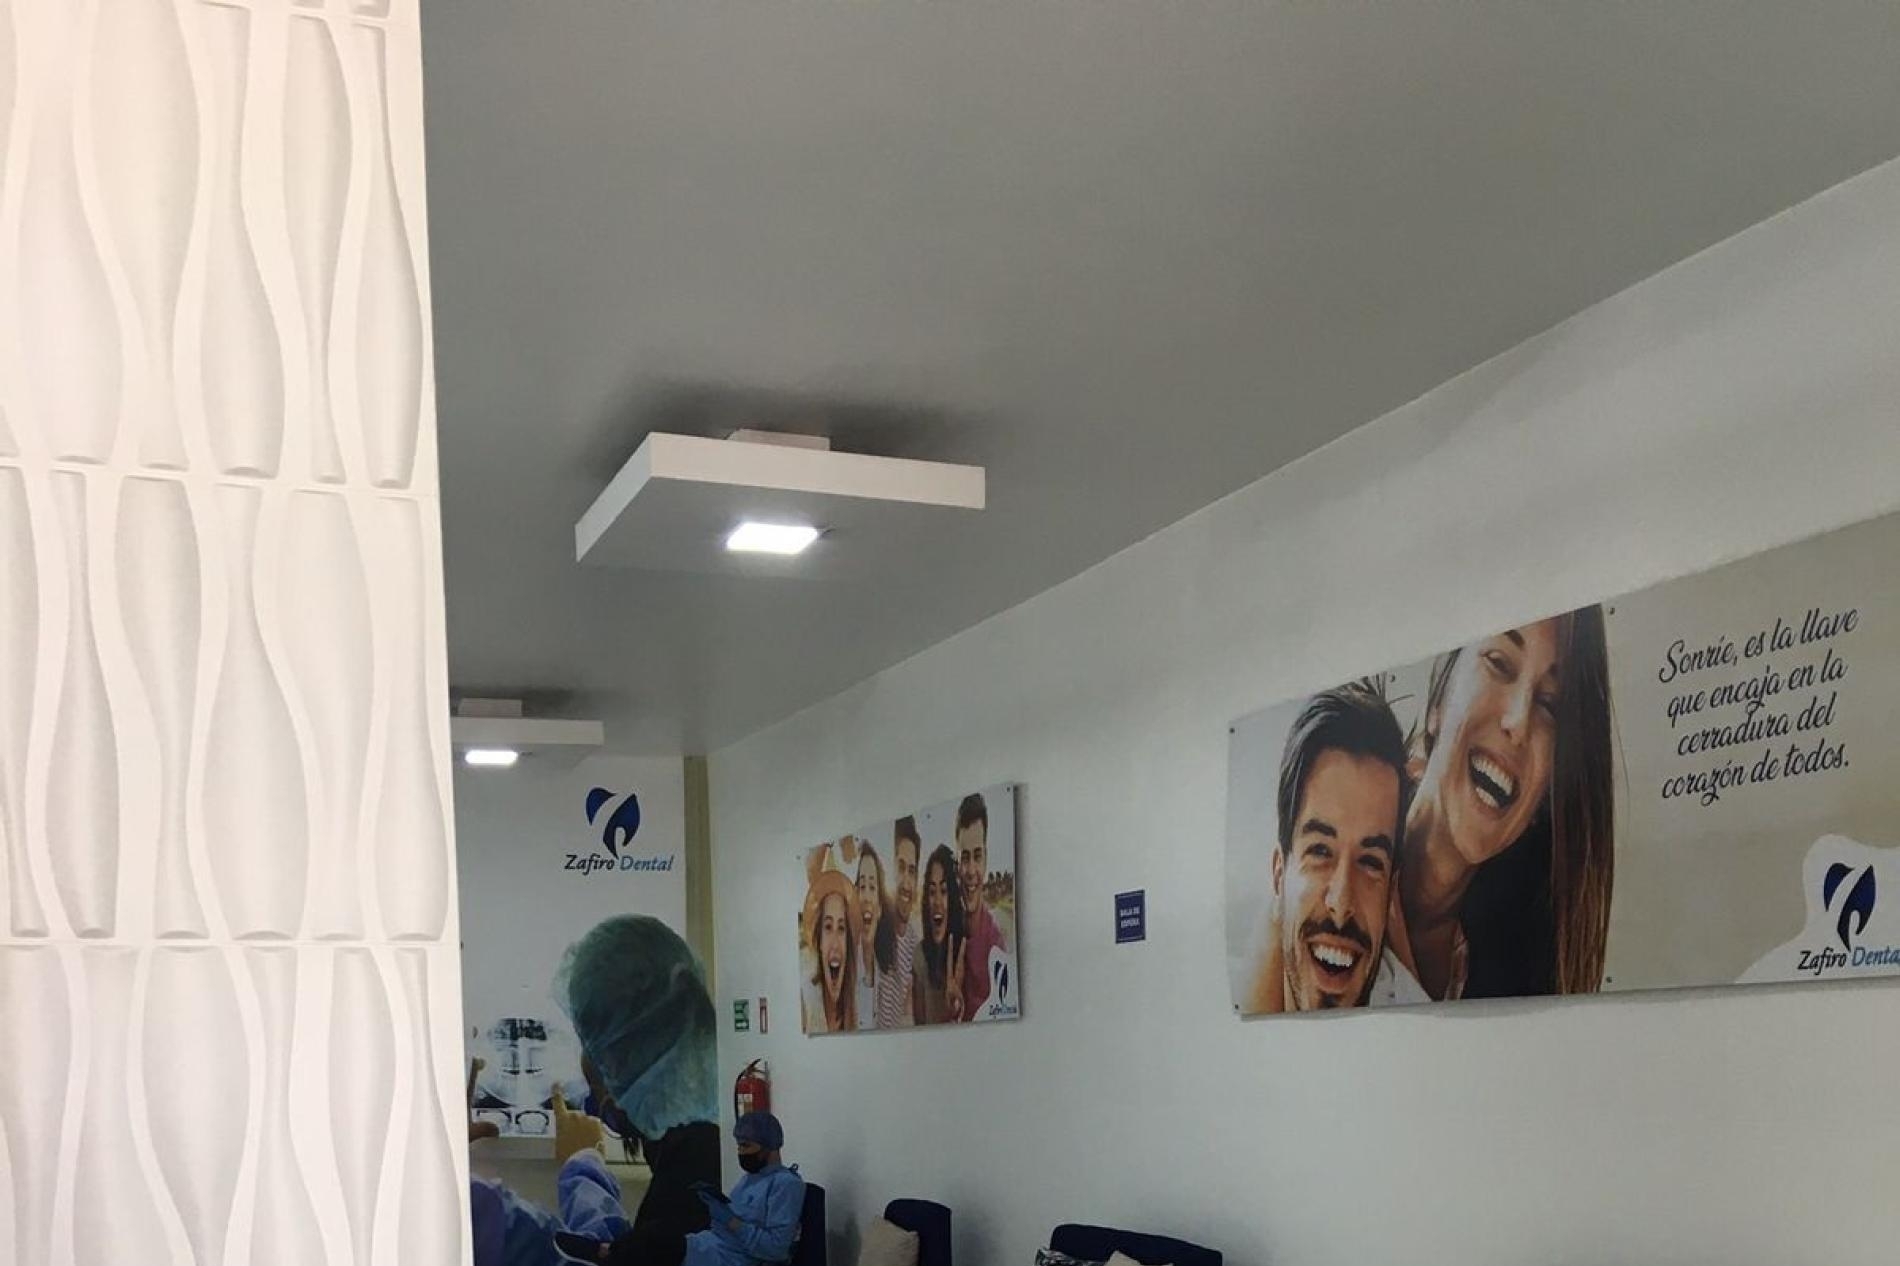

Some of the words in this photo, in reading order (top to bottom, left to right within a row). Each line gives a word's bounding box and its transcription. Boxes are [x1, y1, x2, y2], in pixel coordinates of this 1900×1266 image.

[1659, 634, 1738, 683] Sonríe,
[1745, 630, 1765, 659] es
[1770, 618, 1796, 652] la
[1800, 608, 1859, 643] llave
[1667, 687, 1709, 728] que
[1710, 664, 1787, 713] encaja
[1789, 664, 1816, 691] en
[1821, 649, 1849, 684] la
[1678, 710, 1794, 756] cerradura
[1797, 692, 1837, 731] del
[1662, 760, 1749, 806] corazón
[1751, 750, 1780, 783] de
[1784, 738, 1849, 777] todos.
[564, 853, 615, 876] Zafiro
[620, 855, 675, 871] Dental
[1797, 947, 1847, 975] Zafiro
[1852, 946, 1900, 966] Denta
